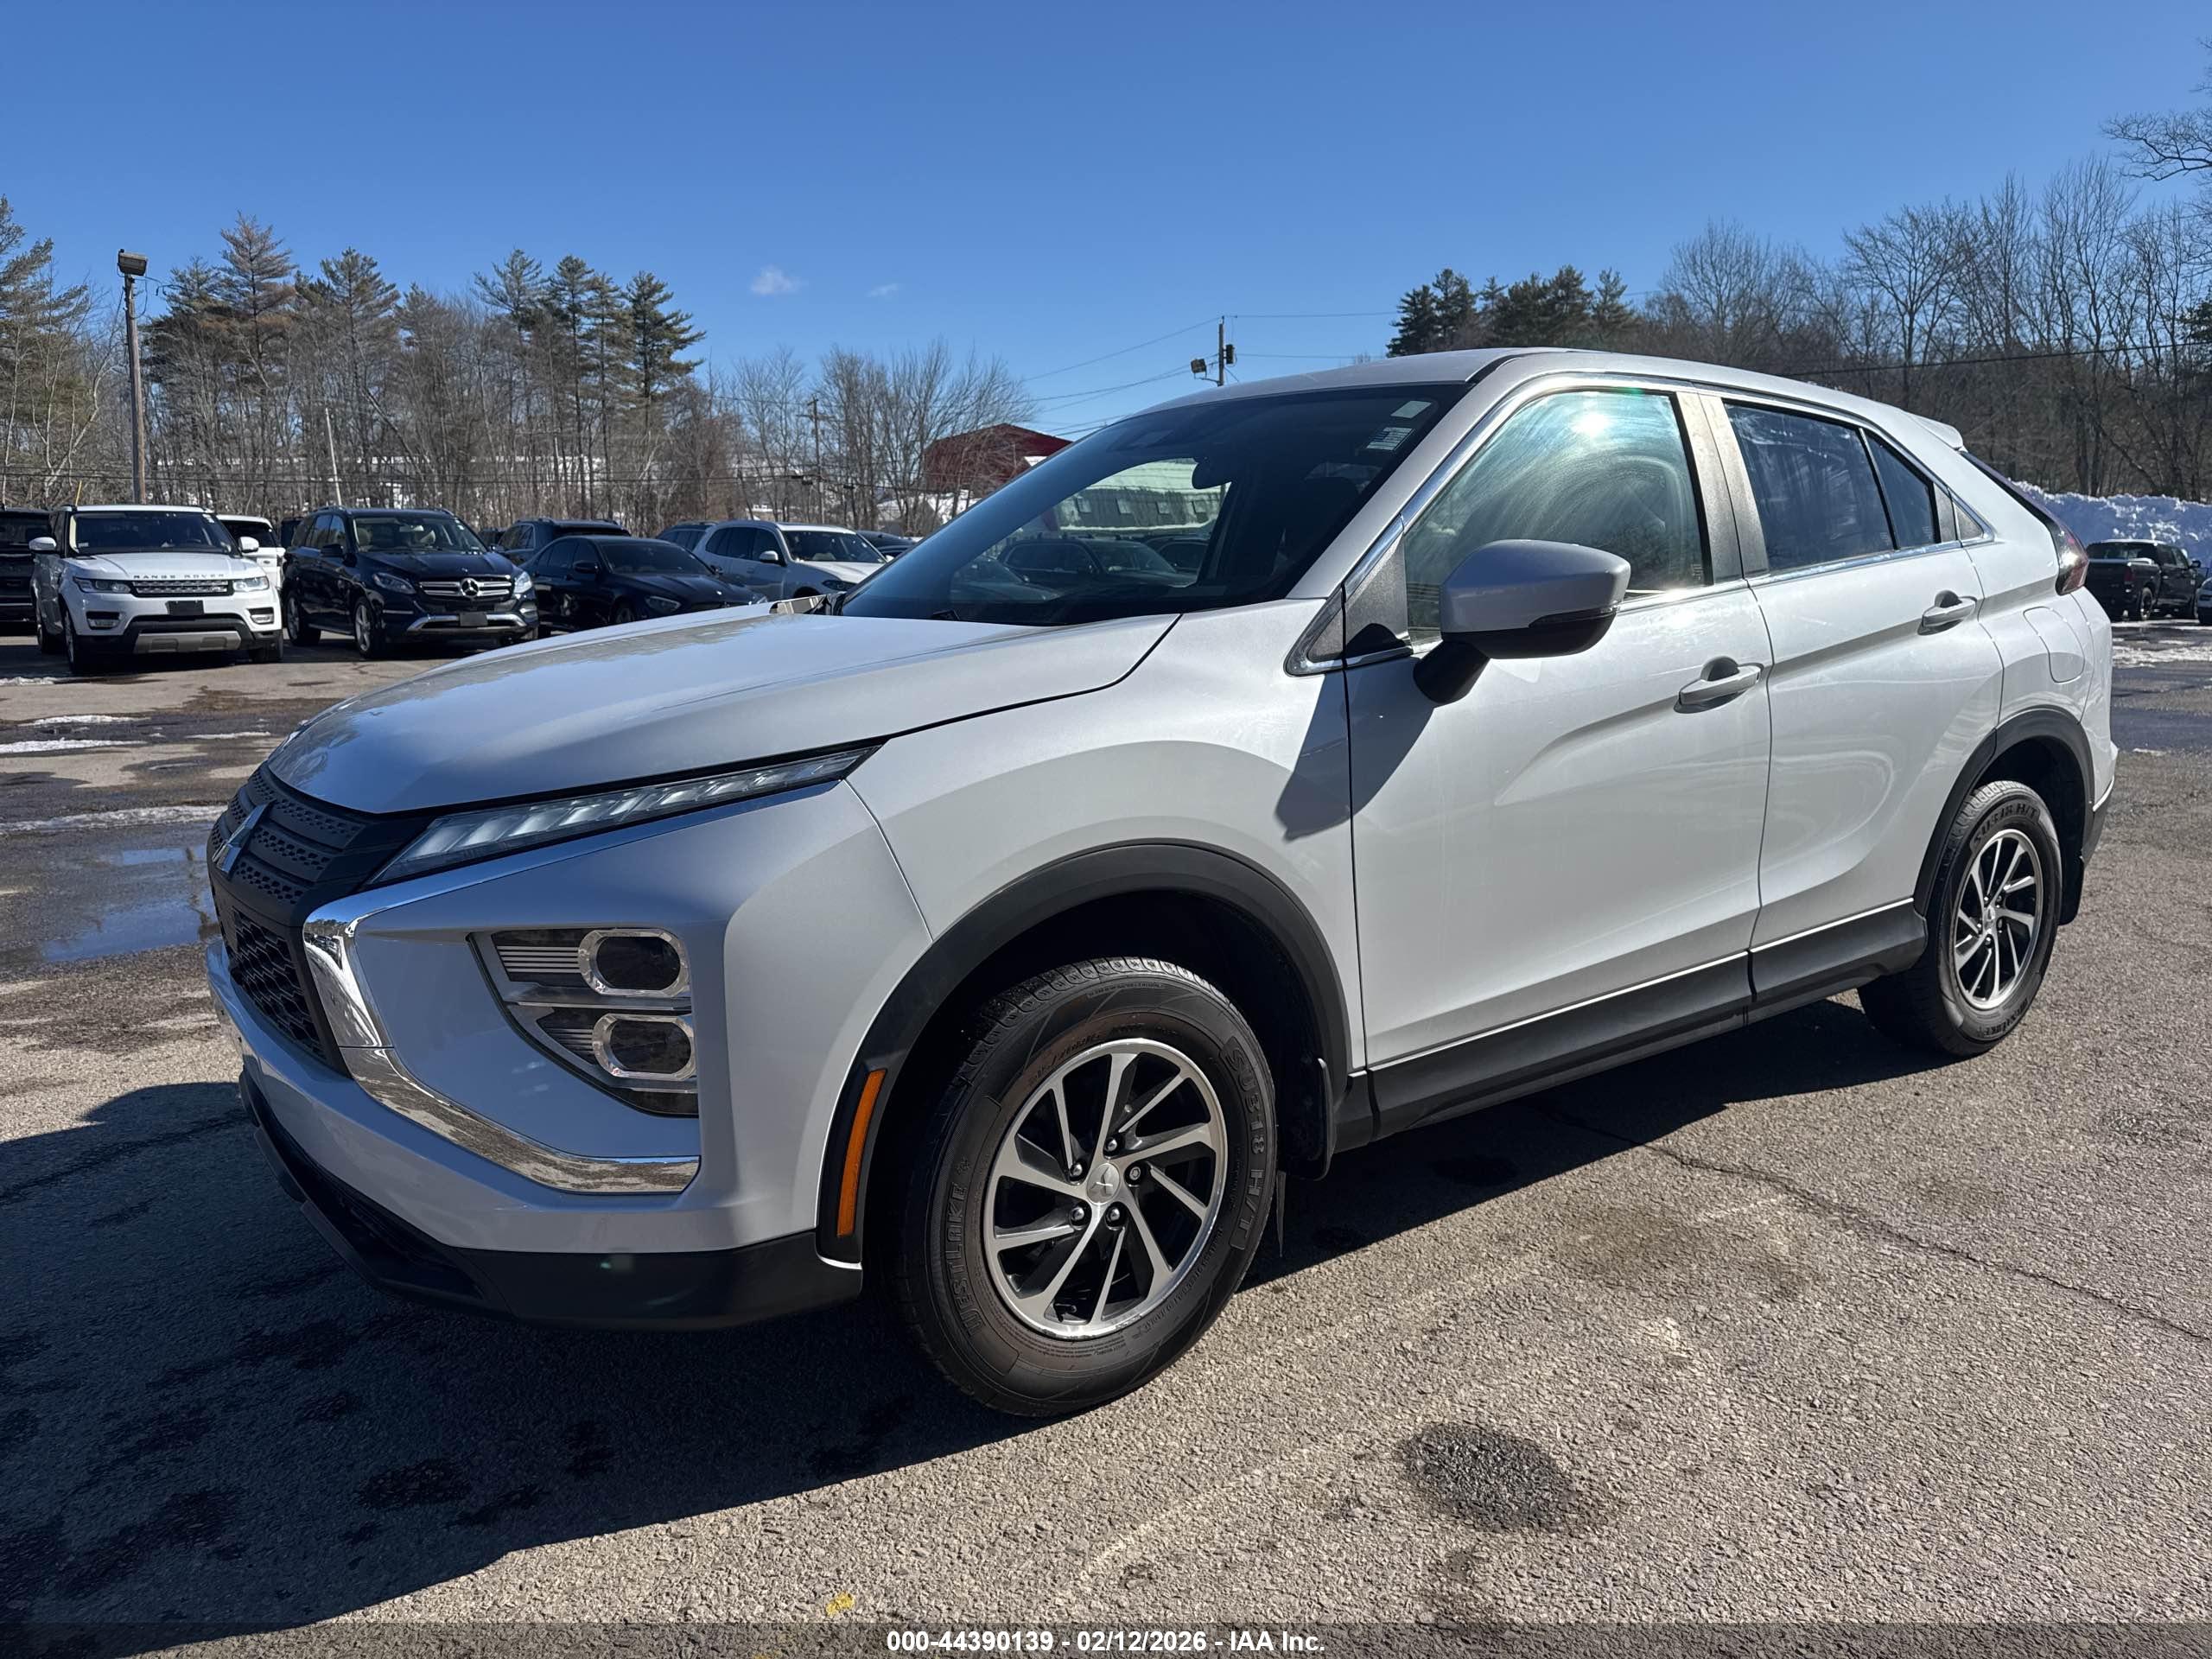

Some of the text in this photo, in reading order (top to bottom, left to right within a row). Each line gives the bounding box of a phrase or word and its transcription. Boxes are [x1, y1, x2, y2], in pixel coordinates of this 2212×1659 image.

[1225, 1048, 1266, 1154] SU318
[1239, 1169, 1265, 1238] H/T
[945, 1182, 985, 1337] WESTLAKE
